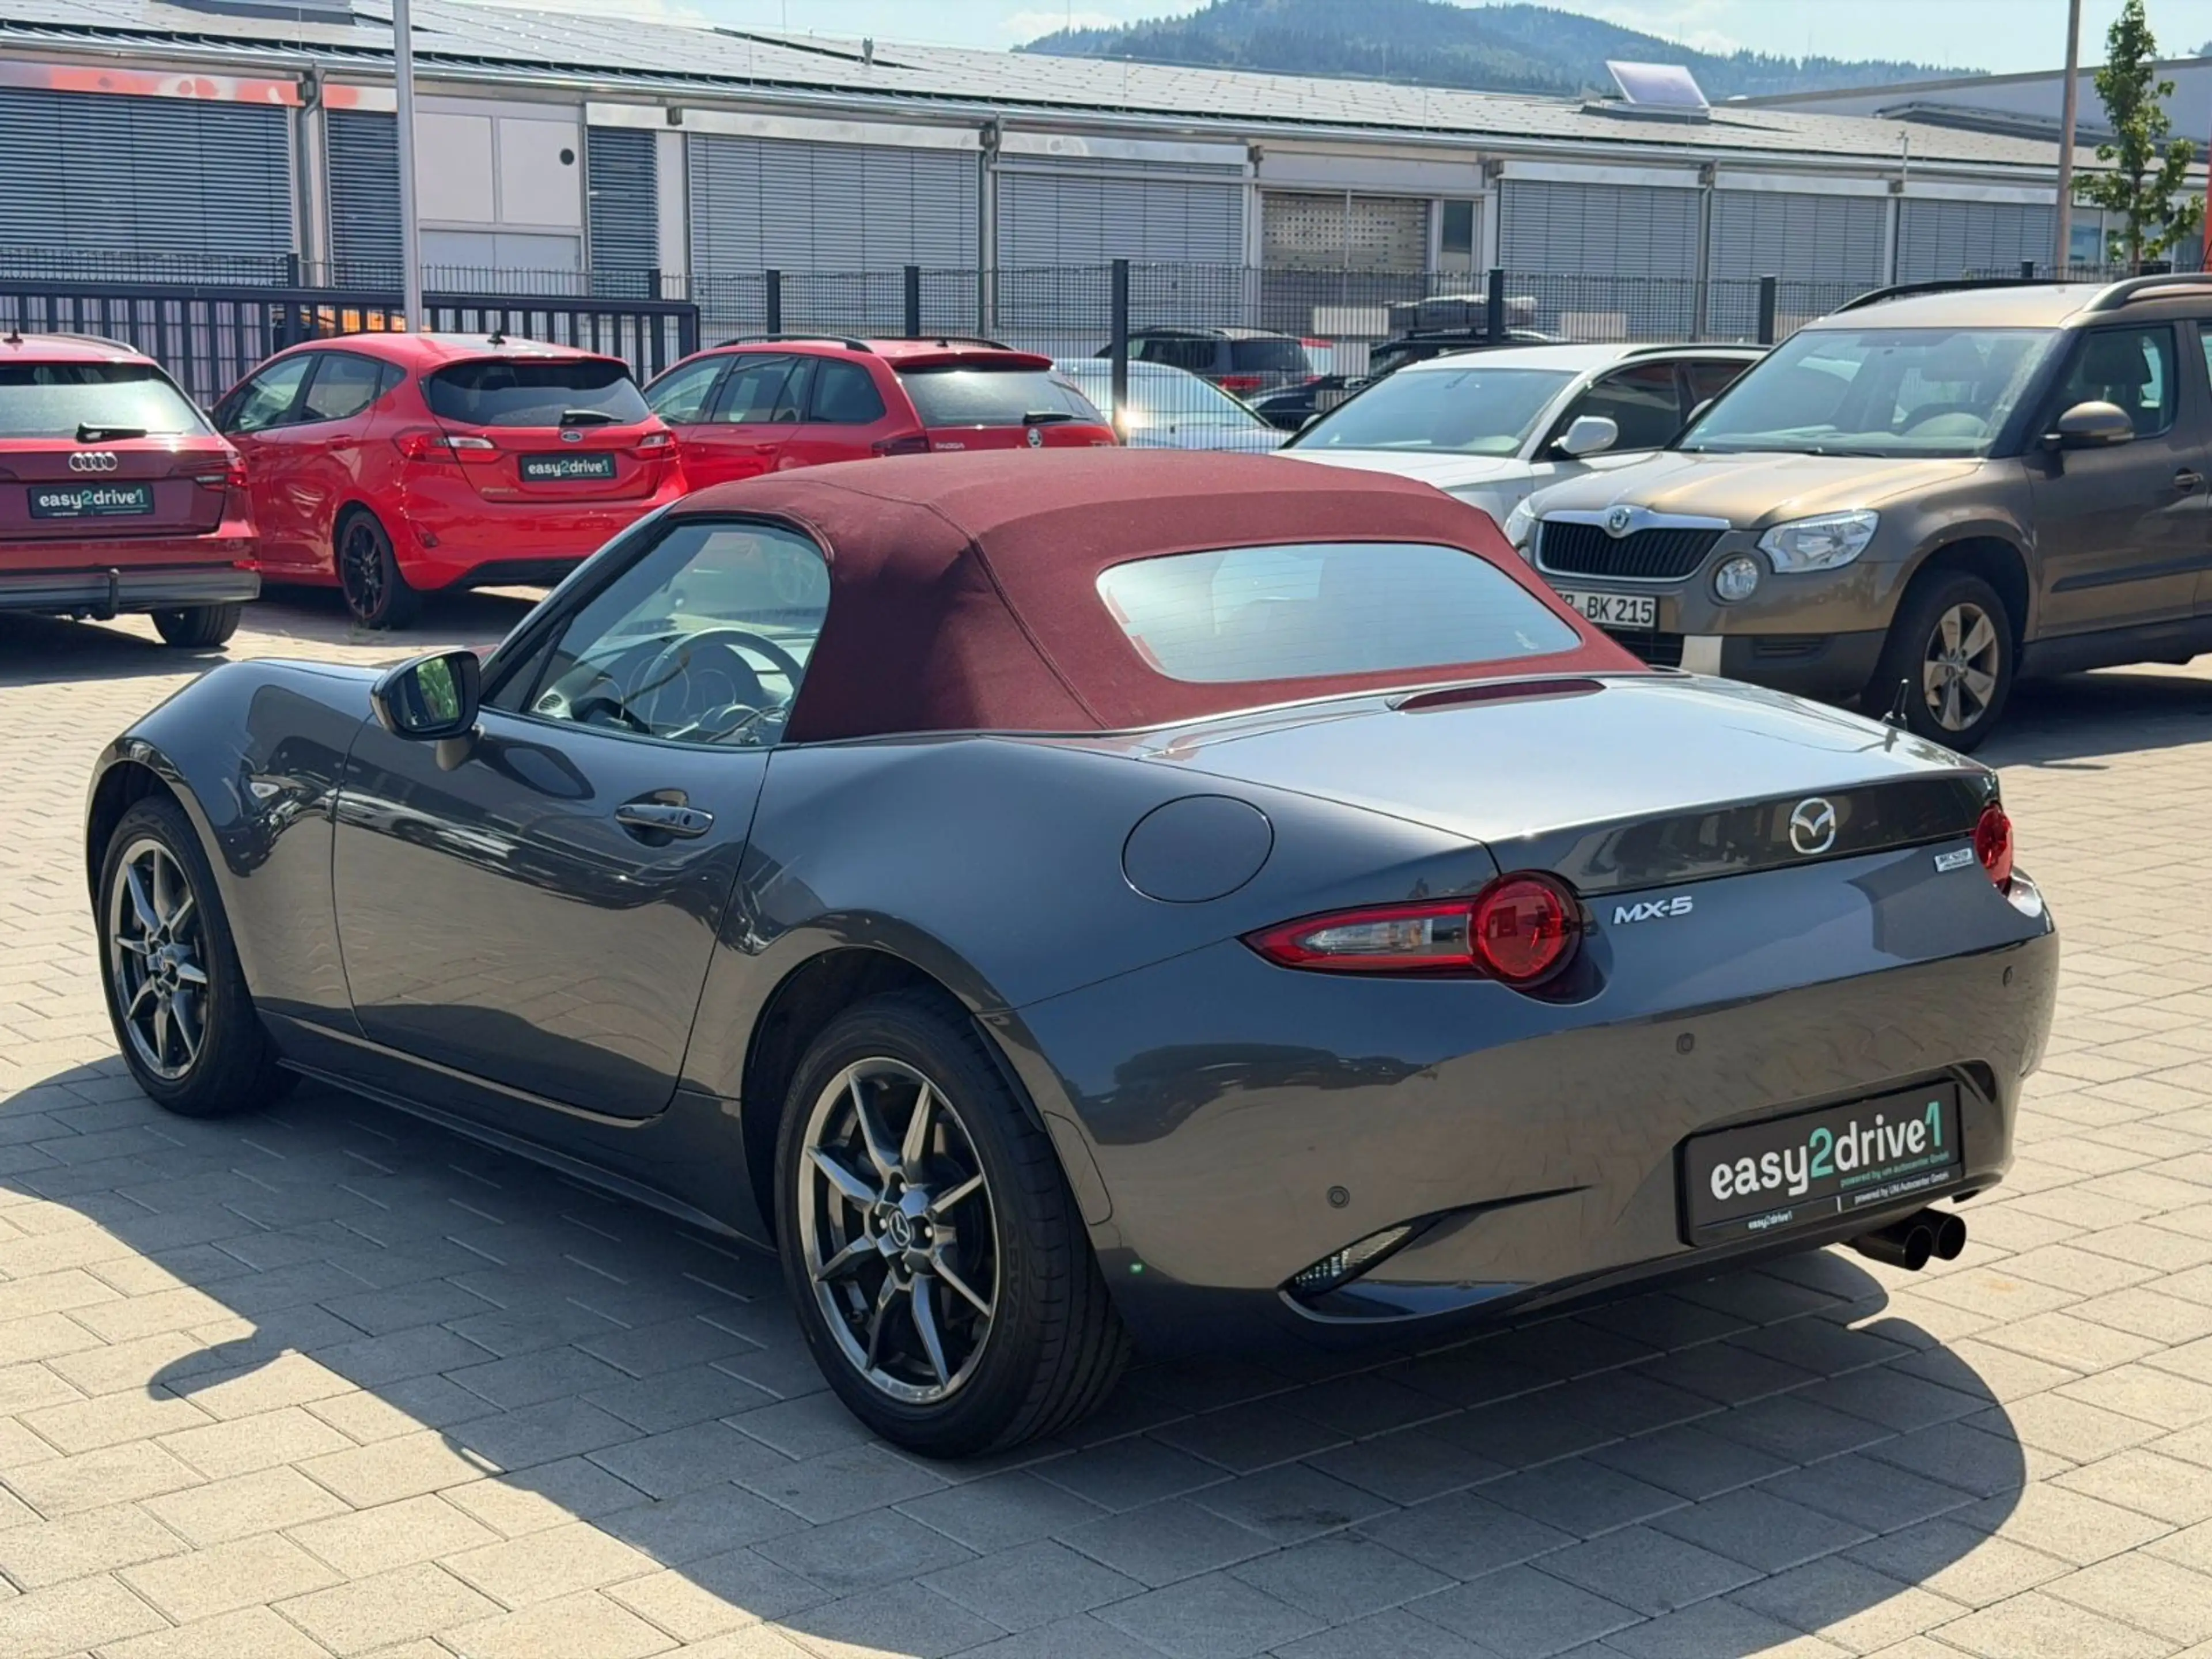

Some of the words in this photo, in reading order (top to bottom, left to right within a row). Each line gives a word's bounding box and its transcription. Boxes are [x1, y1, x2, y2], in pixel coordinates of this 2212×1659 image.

[528, 459, 609, 476] easy2drive1
[39, 488, 143, 509] easy2drive1
[1587, 596, 1612, 620] BK
[1615, 598, 1653, 624] 215
[1613, 896, 1692, 925] MX-5
[1710, 1101, 1942, 1201] easy2drive1
